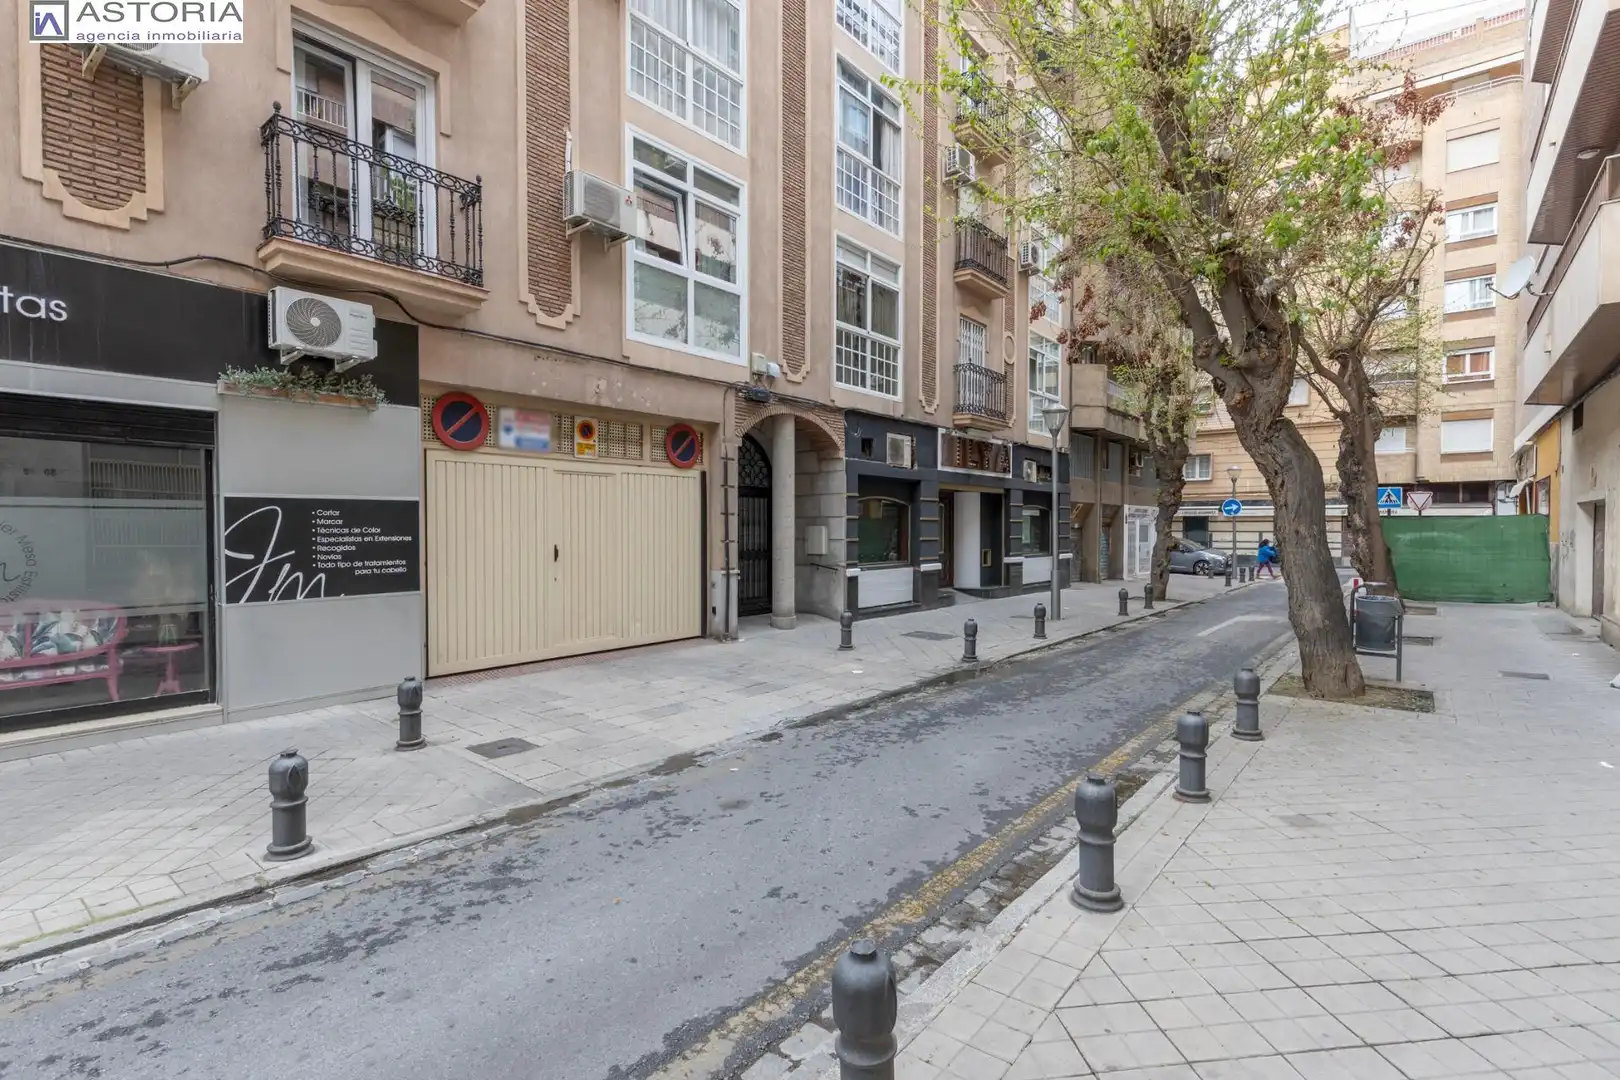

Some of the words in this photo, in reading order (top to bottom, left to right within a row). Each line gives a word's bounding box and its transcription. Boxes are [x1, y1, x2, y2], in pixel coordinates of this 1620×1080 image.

[317, 535, 362, 543] Especialistas
[317, 544, 356, 552] Recogidos
[337, 561, 351, 569] tipo
[381, 566, 407, 574] cabello
